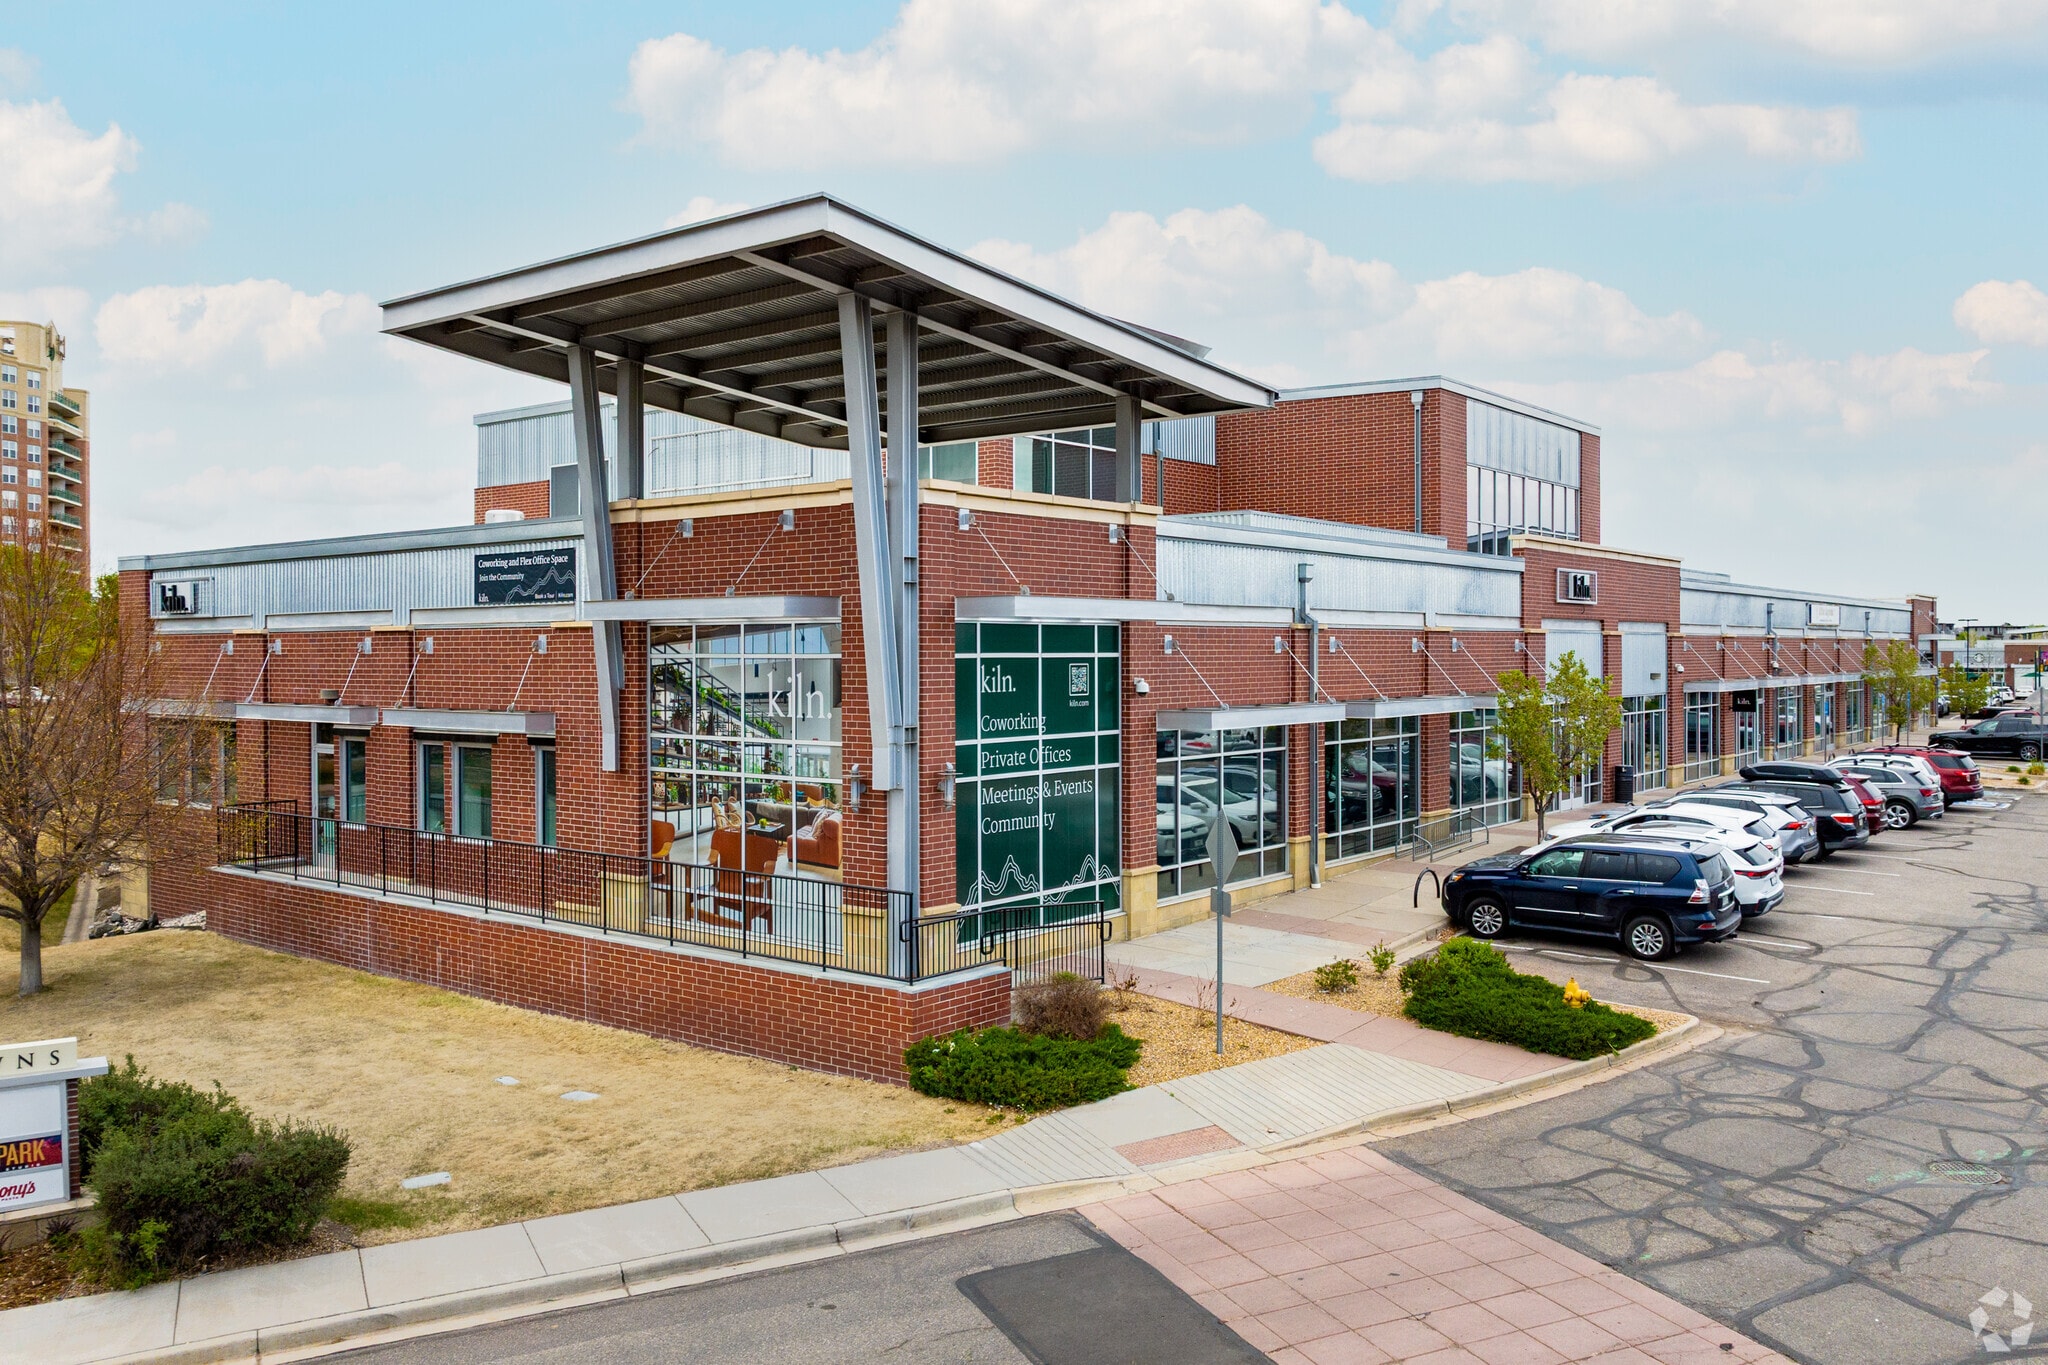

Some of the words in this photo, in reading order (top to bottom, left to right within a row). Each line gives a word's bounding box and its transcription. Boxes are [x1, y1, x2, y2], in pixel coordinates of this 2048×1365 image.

[478, 558, 508, 568] Coworking
[509, 557, 519, 566] and
[520, 556, 532, 566] Flex
[532, 555, 550, 565] Office
[551, 554, 568, 566] Space
[479, 573, 488, 583] Join
[489, 573, 497, 581] the
[497, 571, 524, 582] Community
[981, 664, 1016, 693] kiln.
[1069, 699, 1089, 707] kiln.com
[981, 745, 1026, 769] Private
[982, 784, 1039, 805] Meetings
[1042, 781, 1051, 798] &
[1054, 778, 1093, 797] Events
[982, 811, 1056, 835] Communty
